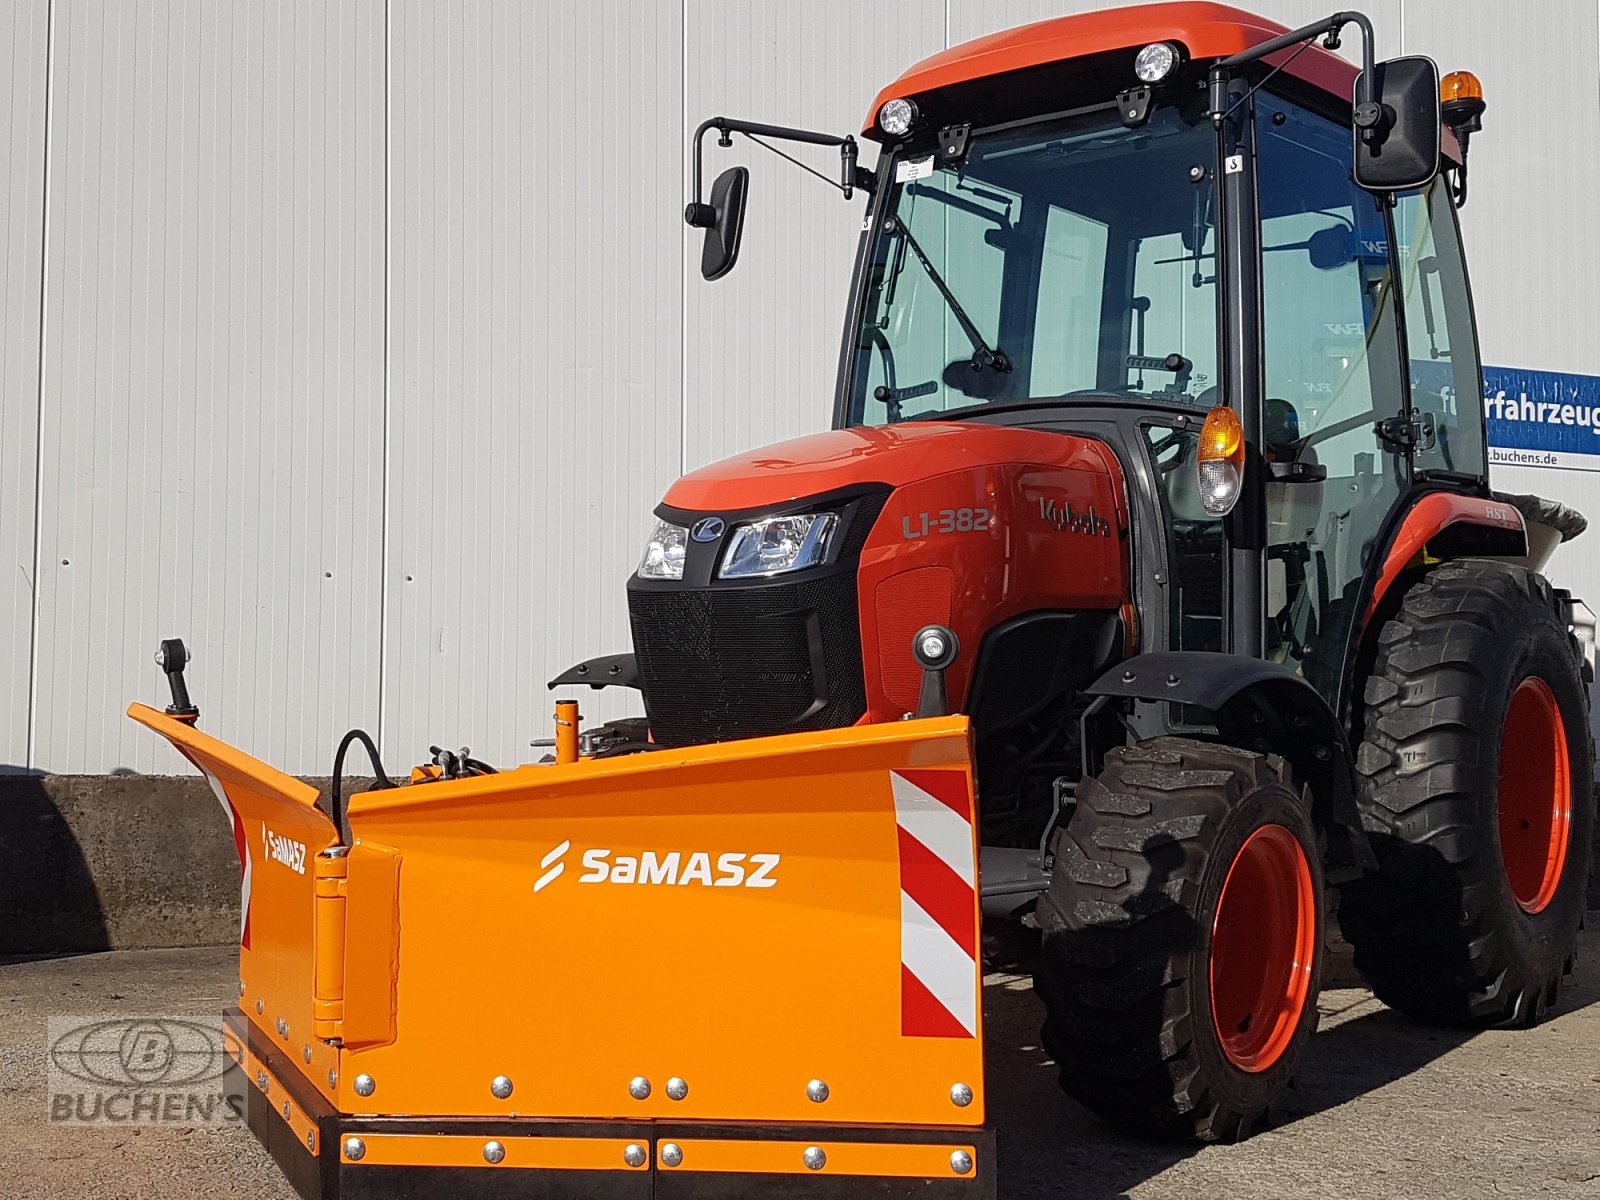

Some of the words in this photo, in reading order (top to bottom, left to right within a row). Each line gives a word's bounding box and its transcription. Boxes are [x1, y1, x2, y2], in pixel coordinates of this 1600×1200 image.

[1488, 449, 1558, 465] .buchens.de
[903, 508, 989, 539] L1-382
[1039, 496, 1111, 538] Kubota
[267, 829, 306, 875] SaMASZ
[577, 848, 781, 888] SaMASZ
